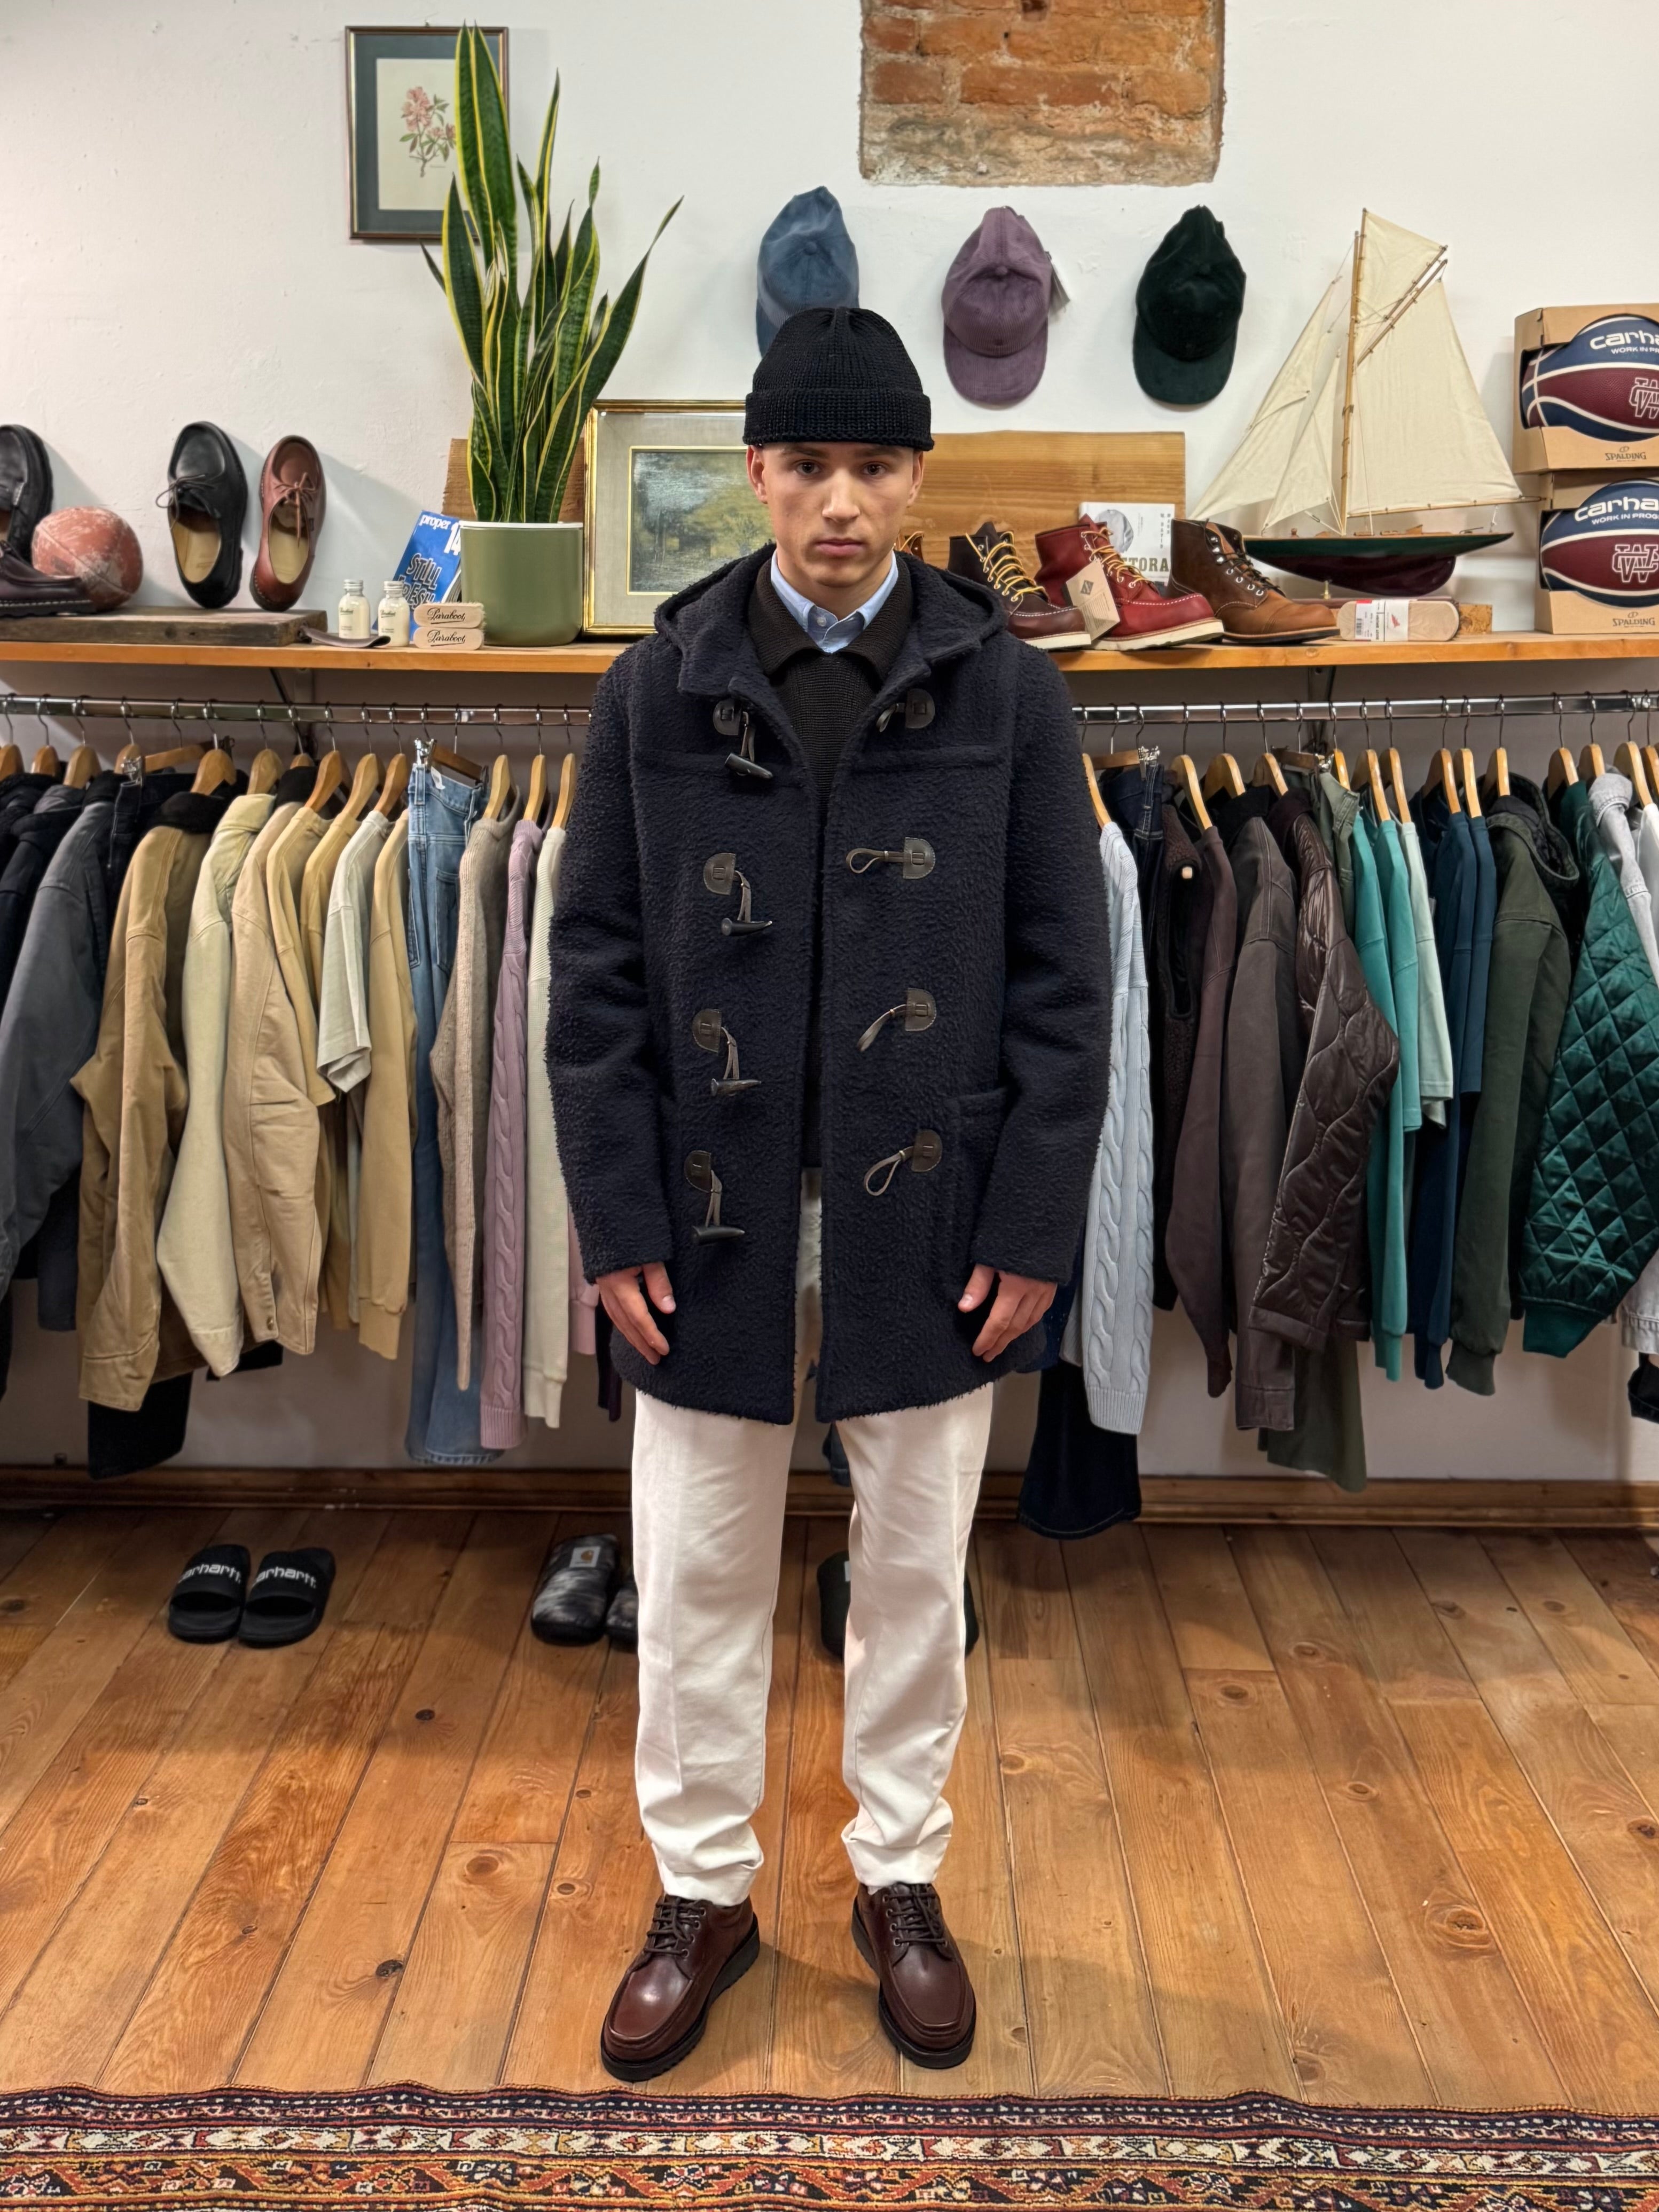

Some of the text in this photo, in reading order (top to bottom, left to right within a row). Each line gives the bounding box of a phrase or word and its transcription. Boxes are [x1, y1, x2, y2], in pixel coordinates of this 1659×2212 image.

[1590, 330, 1659, 350] carh
[1610, 347, 1638, 355] WORK
[1605, 452, 1647, 461] SPALDING
[419, 514, 451, 530] proper
[1591, 514, 1619, 525] WORK
[444, 522, 461, 555] 14
[406, 552, 442, 590] STILL
[1123, 557, 1169, 572] TORA
[427, 607, 465, 623] Paraboot
[1612, 617, 1656, 626] SPALDING
[427, 629, 466, 646] Paraboot
